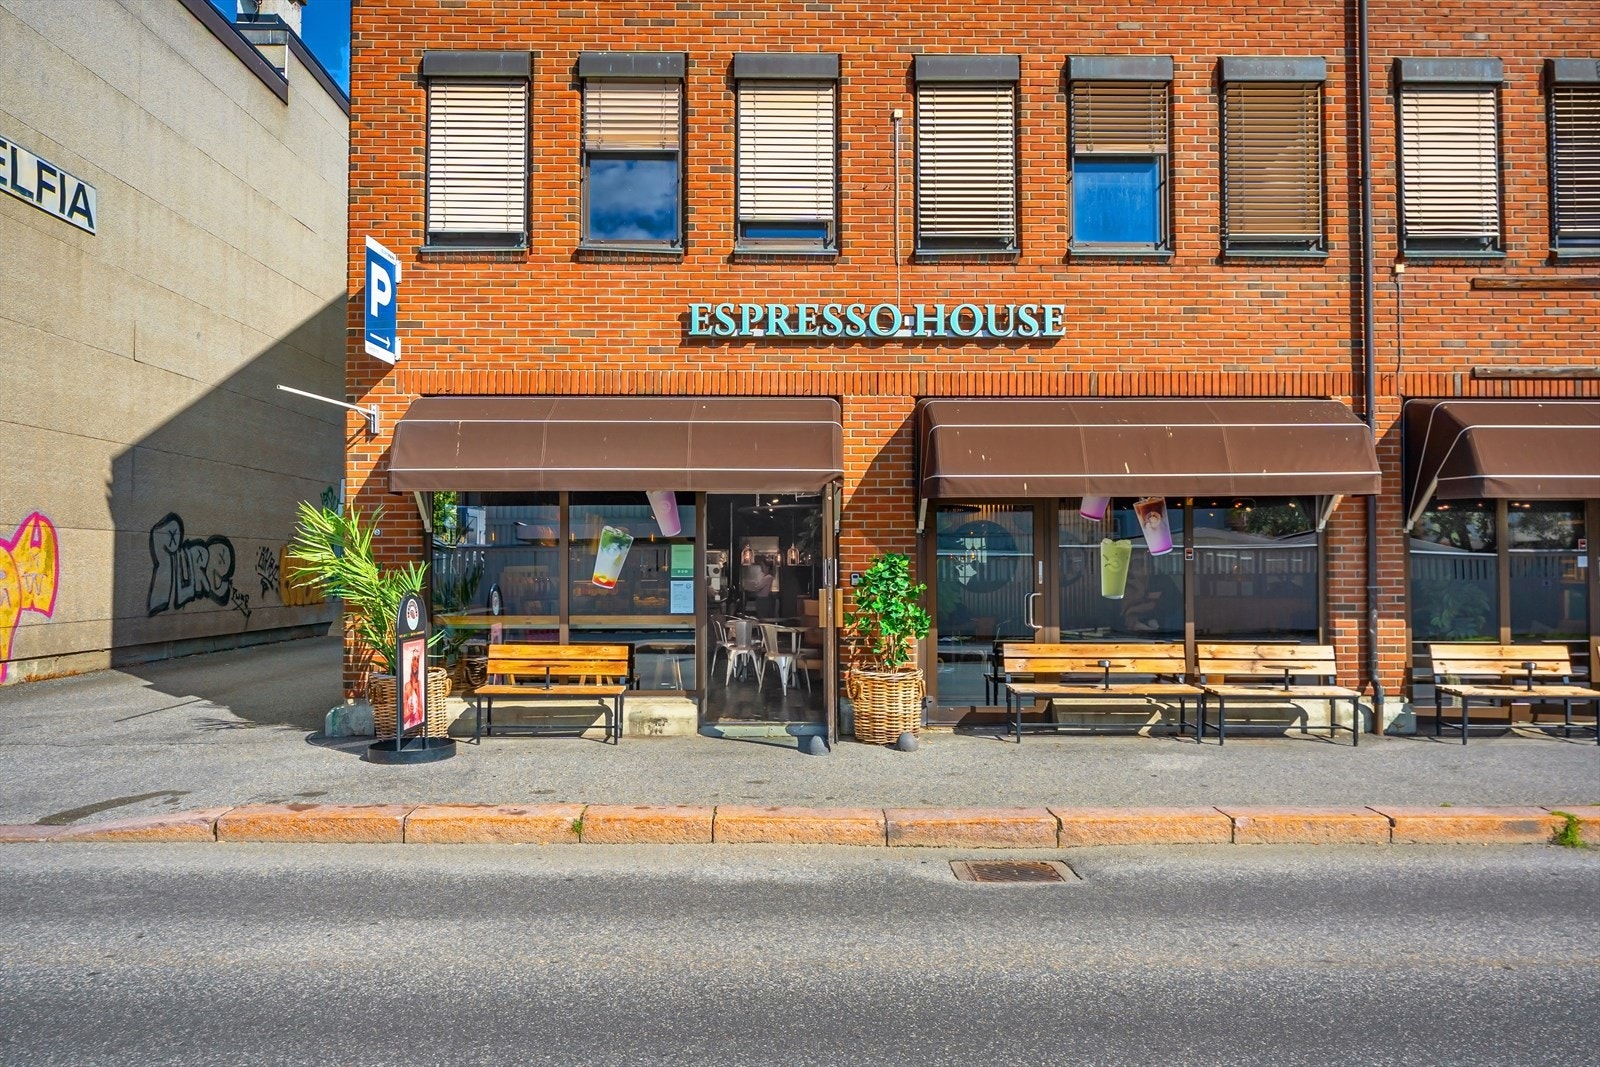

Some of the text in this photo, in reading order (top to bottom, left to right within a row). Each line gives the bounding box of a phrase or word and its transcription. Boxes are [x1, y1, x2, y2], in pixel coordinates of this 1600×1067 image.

[370, 261, 392, 317] P
[688, 303, 1067, 337] ESPRESSO HOUSE
